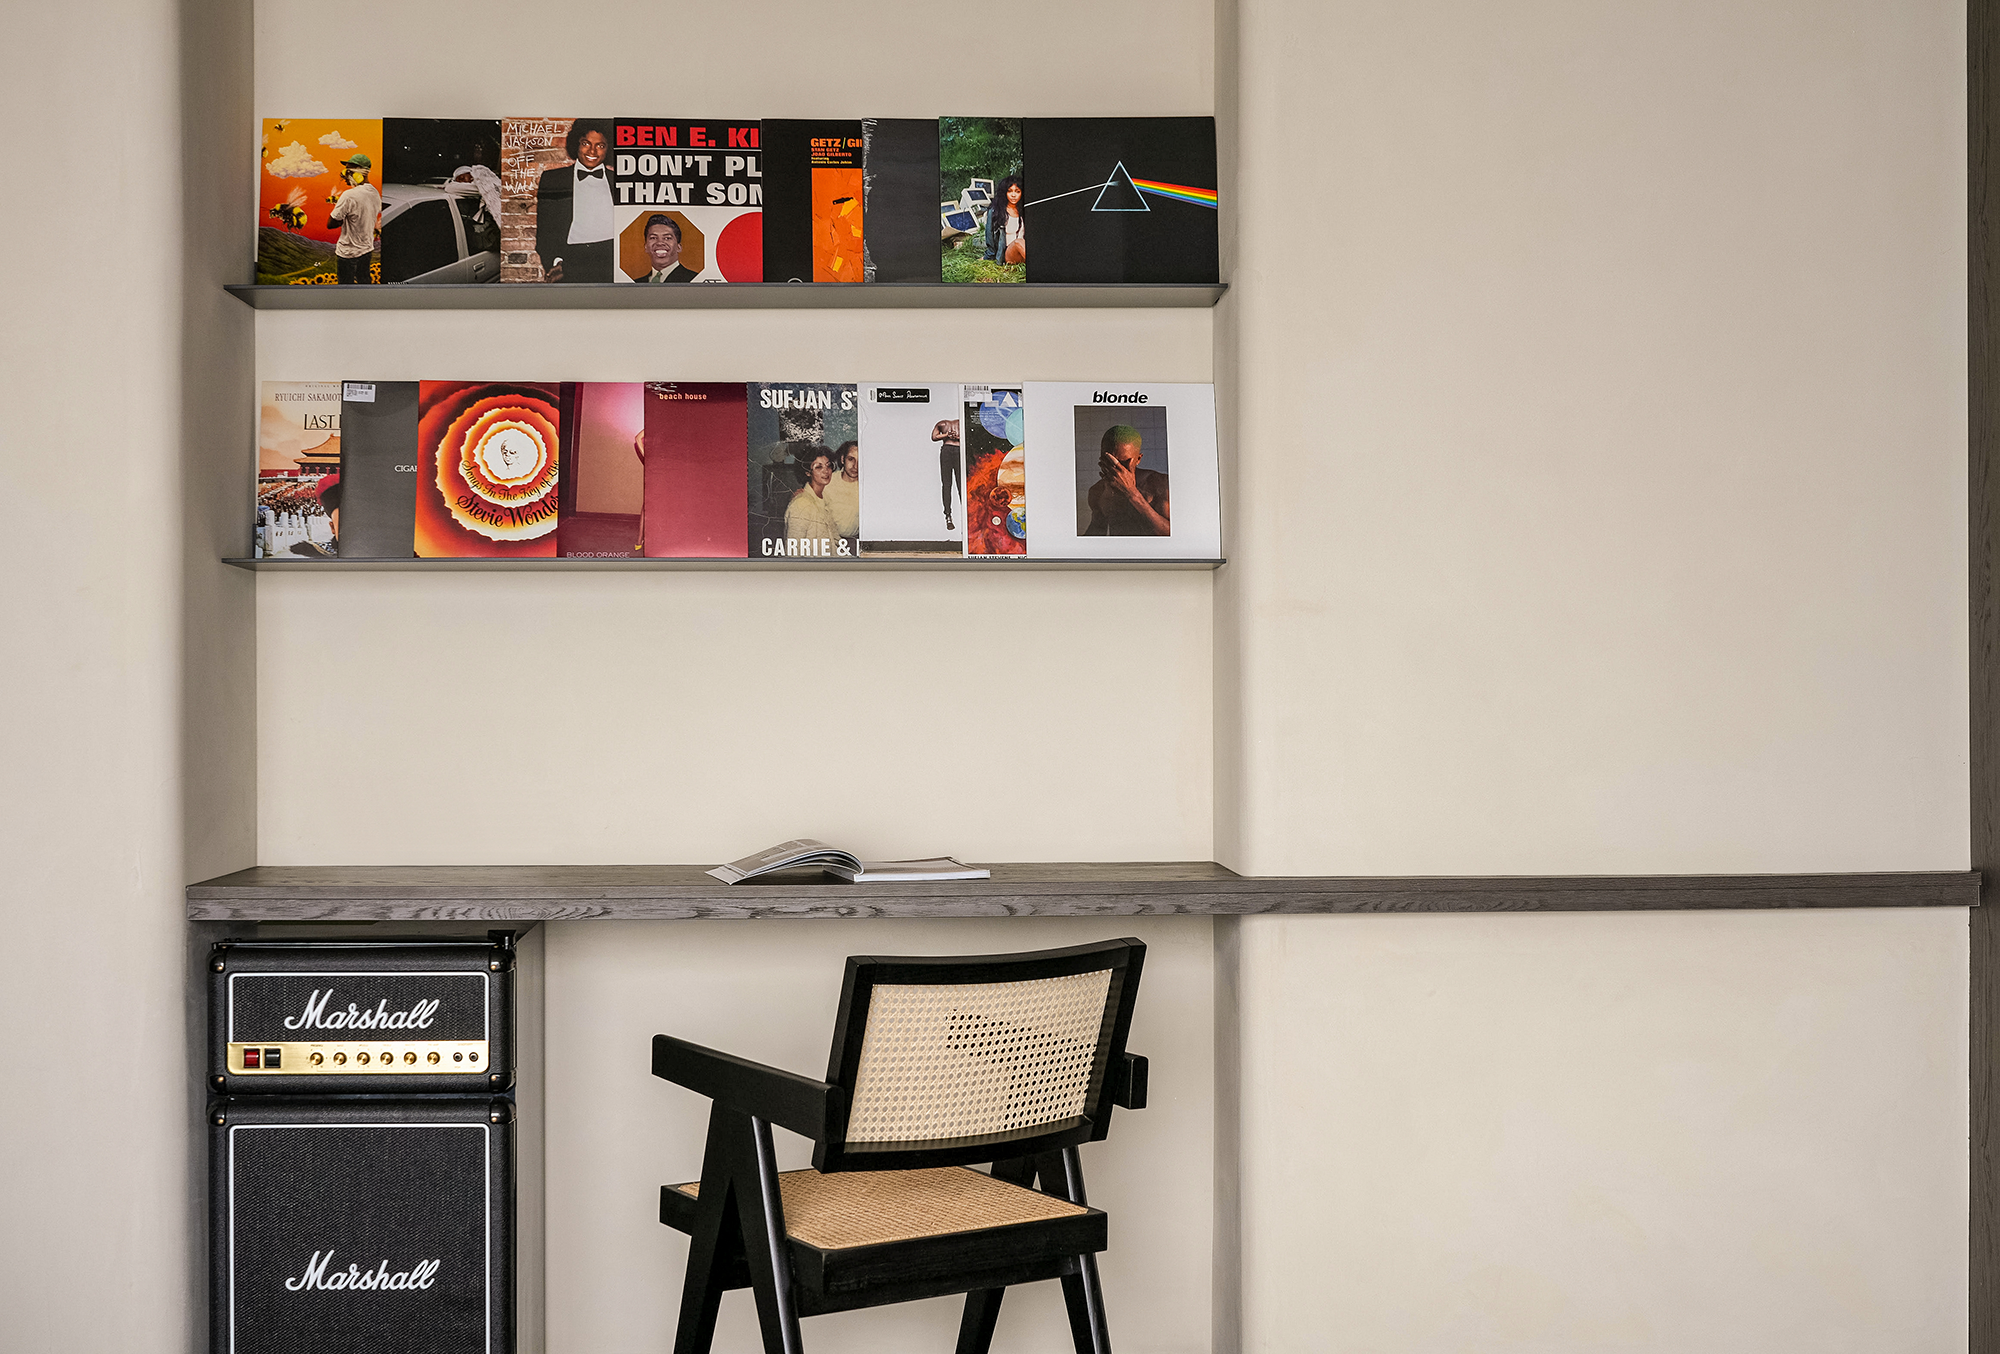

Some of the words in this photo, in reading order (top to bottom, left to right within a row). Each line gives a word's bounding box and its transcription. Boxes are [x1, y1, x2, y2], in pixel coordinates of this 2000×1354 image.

[506, 122, 562, 136] MICHAEL
[616, 125, 677, 146] BEN
[690, 126, 716, 147] E.
[506, 136, 553, 149] JACKSON
[507, 155, 535, 168] OFF
[616, 154, 713, 177] DON'T
[511, 168, 536, 179] THE
[505, 181, 535, 194] WALL
[615, 182, 695, 204] THAT
[275, 393, 305, 402] RYUICHI
[760, 389, 832, 410] SUFJAN
[1092, 390, 1149, 404] blonde
[304, 413, 336, 430] LAST
[461, 460, 484, 490] Songs
[482, 483, 497, 499] In
[498, 489, 518, 501] The
[520, 486, 542, 498] Key
[539, 477, 552, 489] of
[455, 494, 504, 527] Stevie
[761, 537, 831, 557] CARRIE
[836, 538, 852, 557] &
[284, 988, 440, 1030] Marshall
[285, 1249, 440, 1291] Marshall
